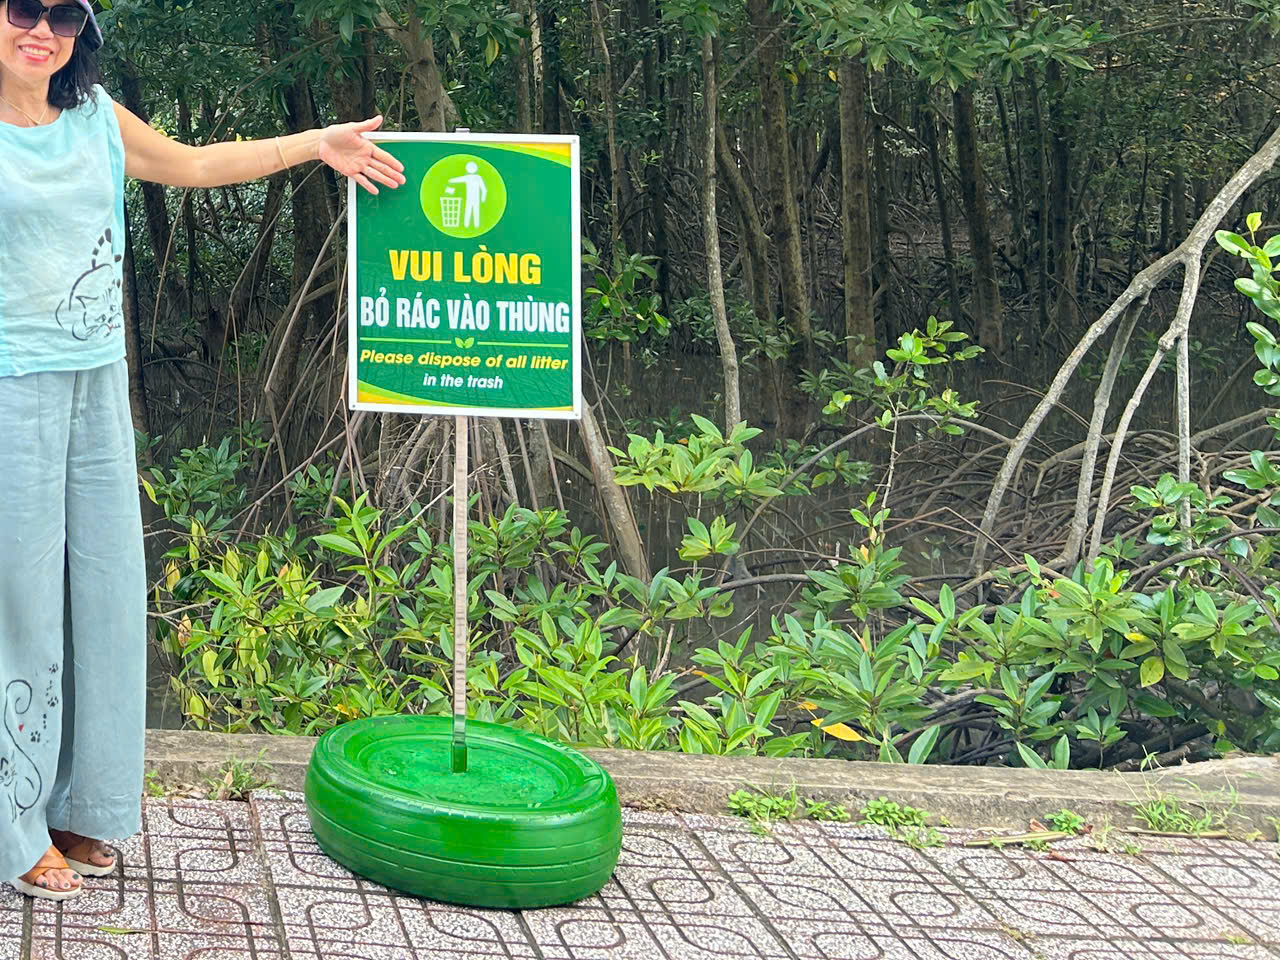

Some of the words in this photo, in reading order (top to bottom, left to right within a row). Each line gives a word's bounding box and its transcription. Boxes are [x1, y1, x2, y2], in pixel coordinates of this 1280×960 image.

[389, 250, 442, 281] VUI
[454, 244, 541, 284] LÒNG
[360, 287, 390, 327] BỎ
[396, 292, 440, 329] RÁC
[446, 293, 490, 330] VÀO
[496, 295, 570, 333] THÙNG
[360, 349, 414, 363] Please
[418, 352, 481, 368] dispose
[485, 354, 504, 367] of
[506, 355, 526, 369] all
[530, 356, 569, 370] litter
[423, 373, 437, 386] in
[440, 374, 463, 387] the
[467, 375, 504, 389] trash
